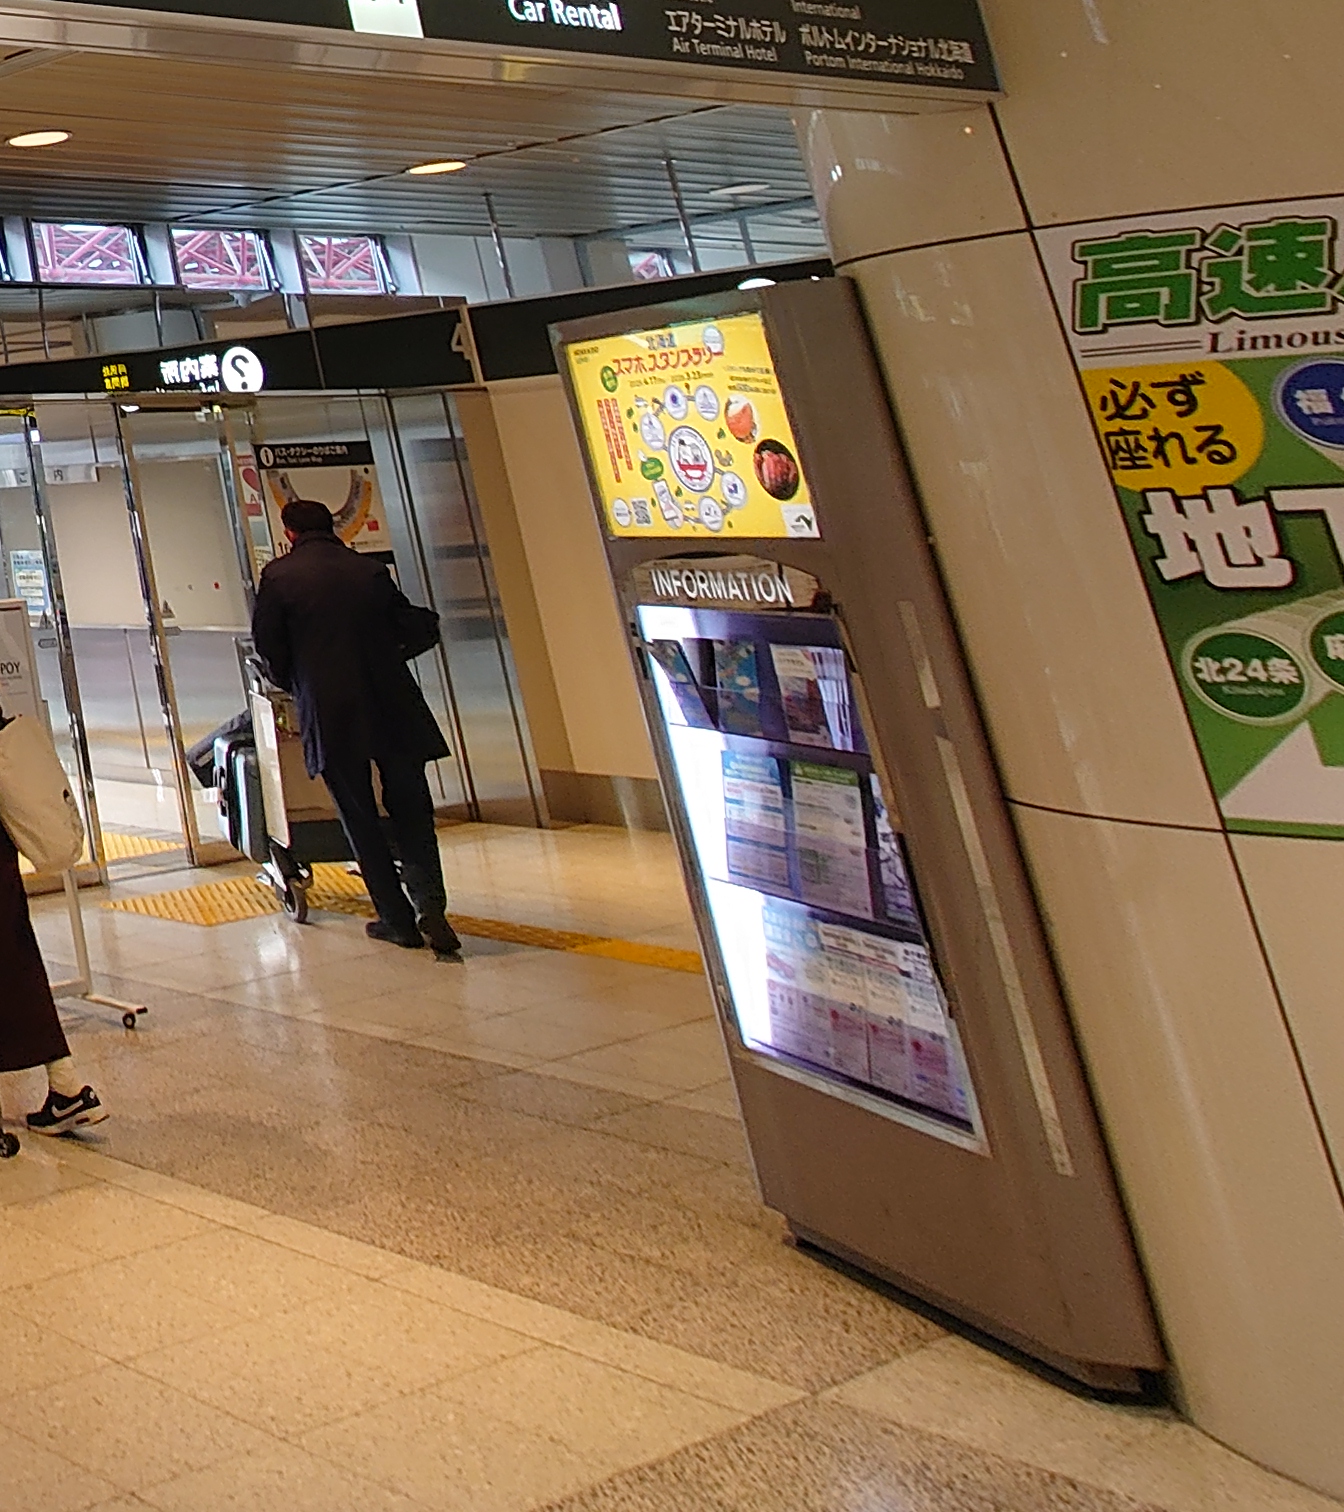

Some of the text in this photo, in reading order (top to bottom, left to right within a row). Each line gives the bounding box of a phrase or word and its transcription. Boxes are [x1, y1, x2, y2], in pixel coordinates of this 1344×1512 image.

[553, 0, 623, 33] Rental
[664, 10, 787, 44] エアターミナルホテル
[673, 37, 778, 62] Air Terminal Hotel
[1072, 216, 1344, 335] 高速
[1100, 371, 1208, 422] 必ず
[1104, 424, 1238, 471] 座れる
[650, 568, 795, 604] INFORMATION
[1193, 656, 1302, 685] 北24条
